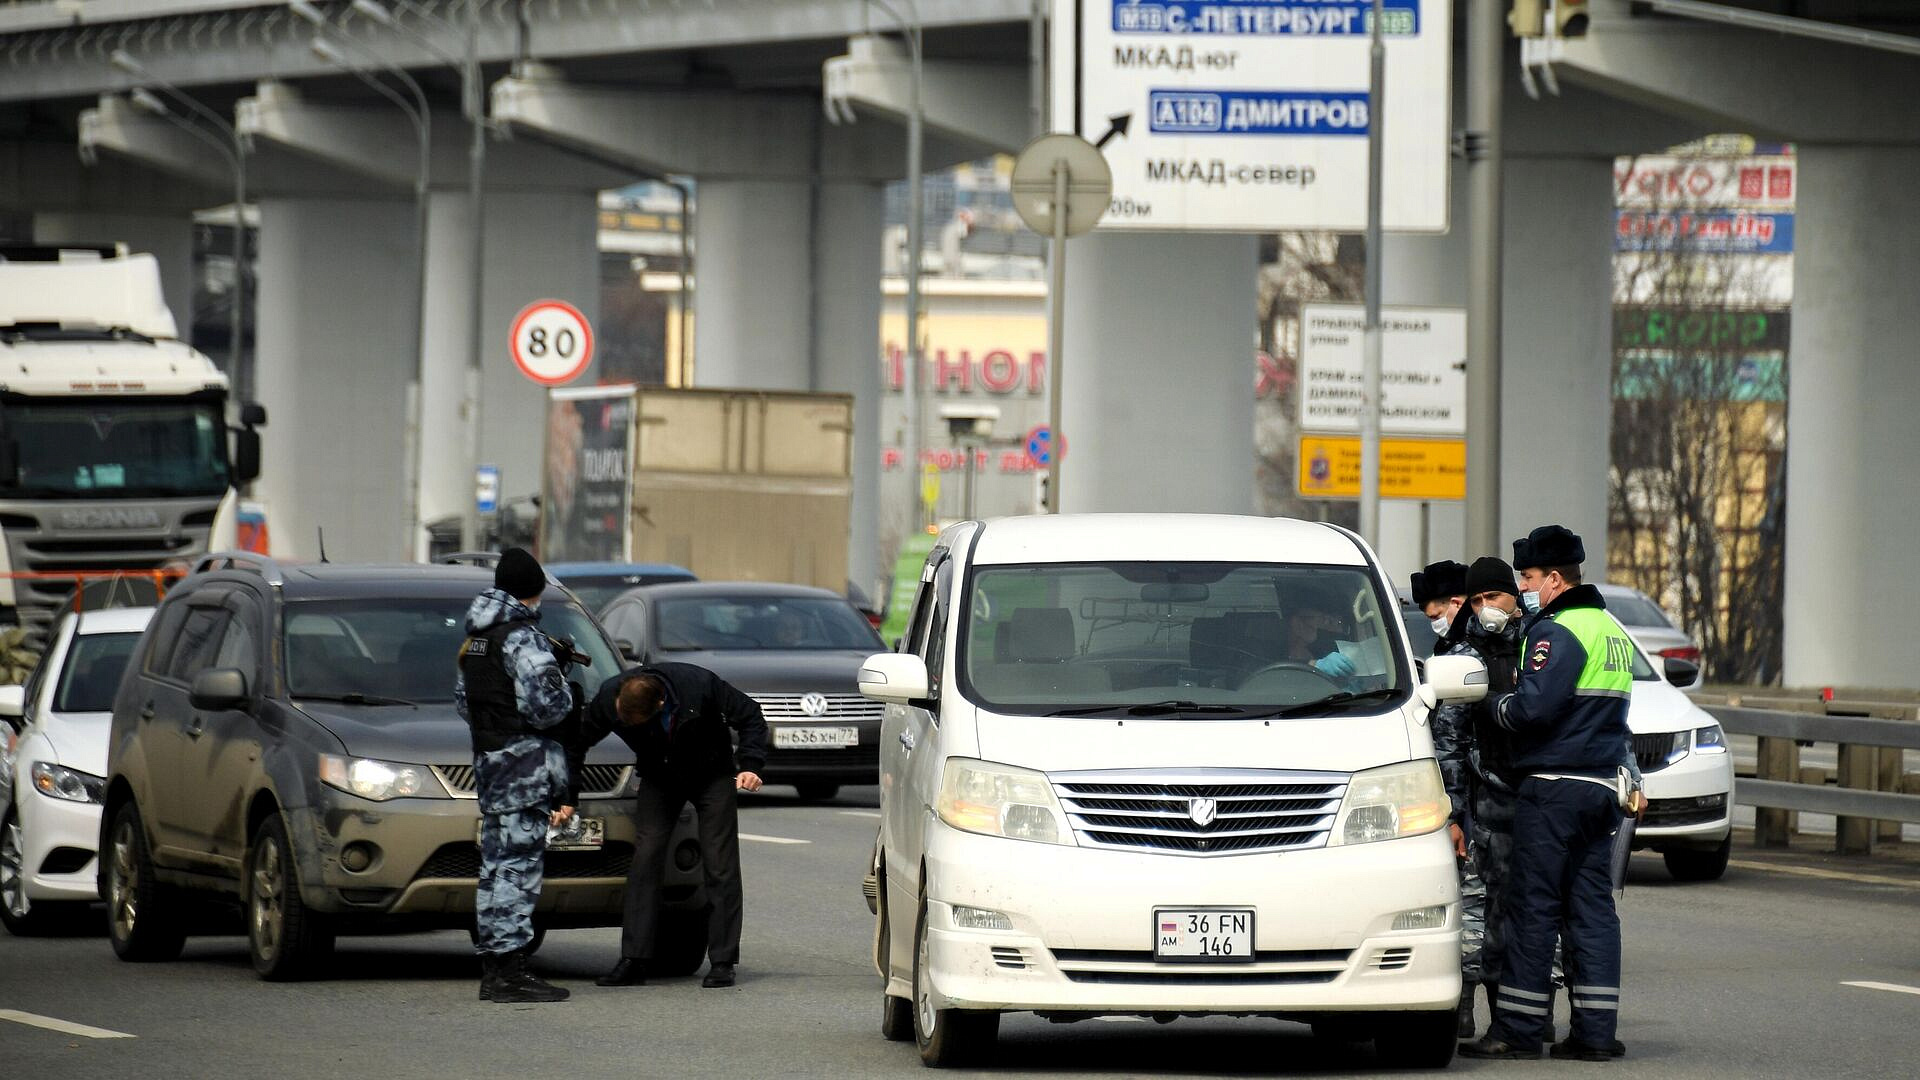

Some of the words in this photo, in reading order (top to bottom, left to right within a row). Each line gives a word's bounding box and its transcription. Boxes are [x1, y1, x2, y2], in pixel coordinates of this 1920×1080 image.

[1114, 46, 1238, 71] МКАД-юг
[1225, 99, 1370, 131] ДМИТРОВ
[1147, 160, 1317, 188] МКАД-север
[1105, 200, 1152, 217] 00м
[528, 326, 574, 359] 80
[60, 510, 160, 529] SCANIA
[1188, 914, 1210, 934] 36
[1219, 914, 1246, 934] FN
[1161, 936, 1178, 947] AM
[1199, 936, 1233, 956] 146
